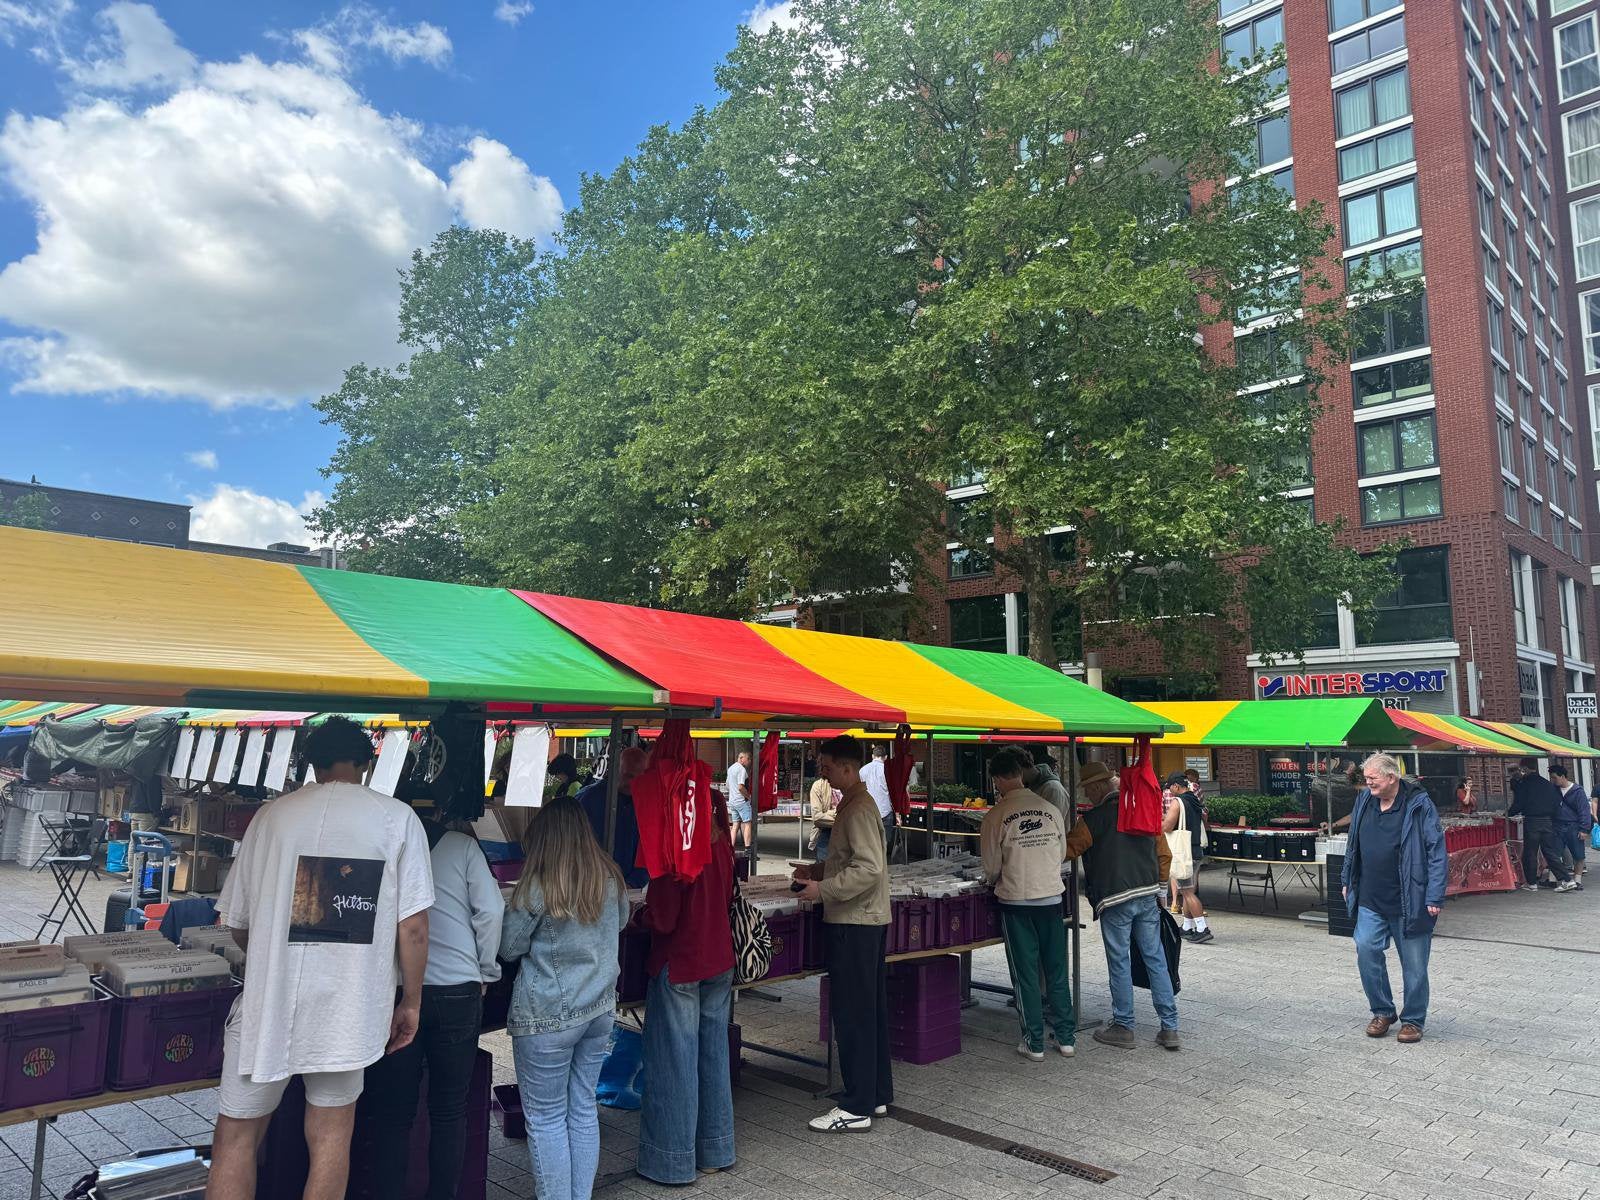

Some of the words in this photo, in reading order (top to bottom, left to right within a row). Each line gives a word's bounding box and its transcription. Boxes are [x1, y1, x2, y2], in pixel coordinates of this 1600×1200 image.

[1286, 669, 1447, 696] INTERSPORT
[1569, 697, 1596, 707] back
[1271, 762, 1287, 770] KOU
[1288, 762, 1300, 770] EN
[1271, 781, 1289, 789] NIET
[1003, 812, 1019, 826] FORD
[1019, 819, 1043, 835] Ford
[171, 966, 193, 974] FLEUR
[18, 979, 48, 989] EAGLES
